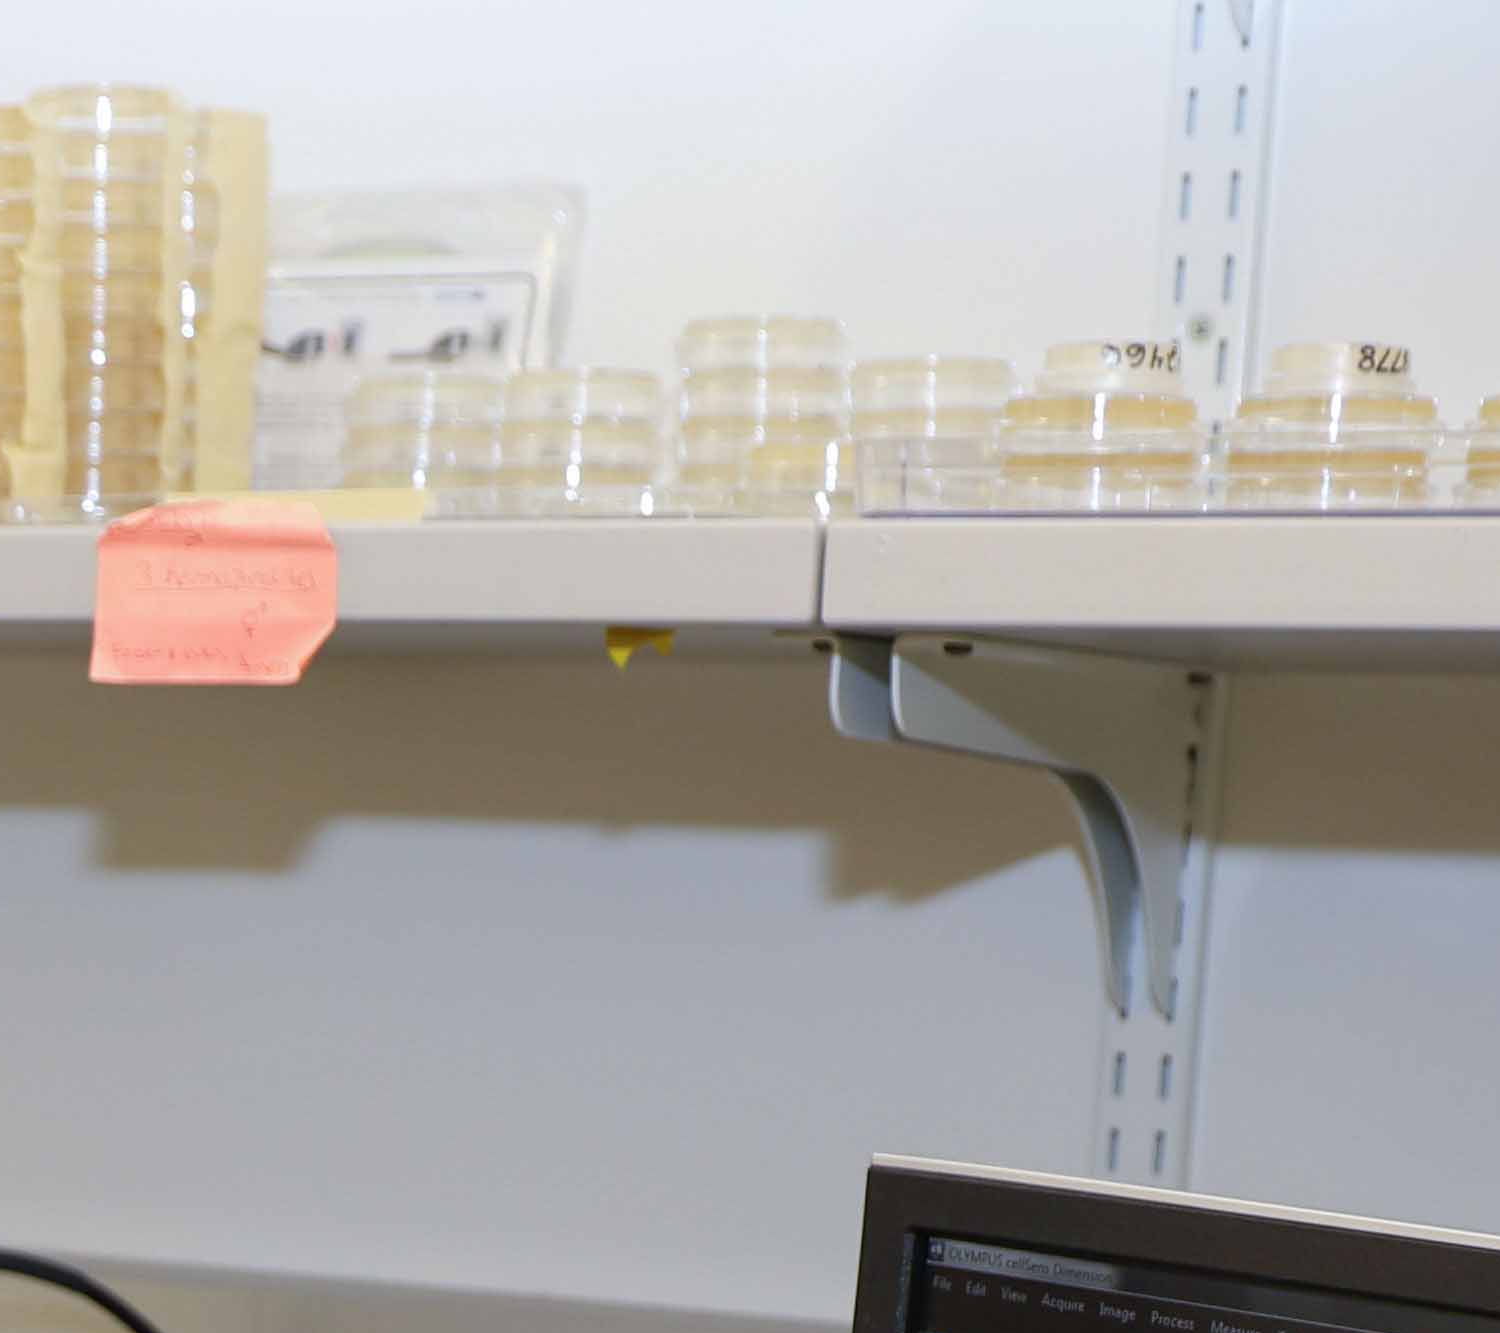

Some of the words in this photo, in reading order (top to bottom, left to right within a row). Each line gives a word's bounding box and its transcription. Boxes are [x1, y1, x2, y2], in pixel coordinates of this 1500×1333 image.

[932, 1275, 952, 1290] File
[965, 1279, 987, 1297] Edit
[1000, 1286, 1028, 1304] View
[1040, 1292, 1086, 1315] Acquire
[1099, 1302, 1137, 1322] Image
[1151, 1309, 1196, 1331] Process
